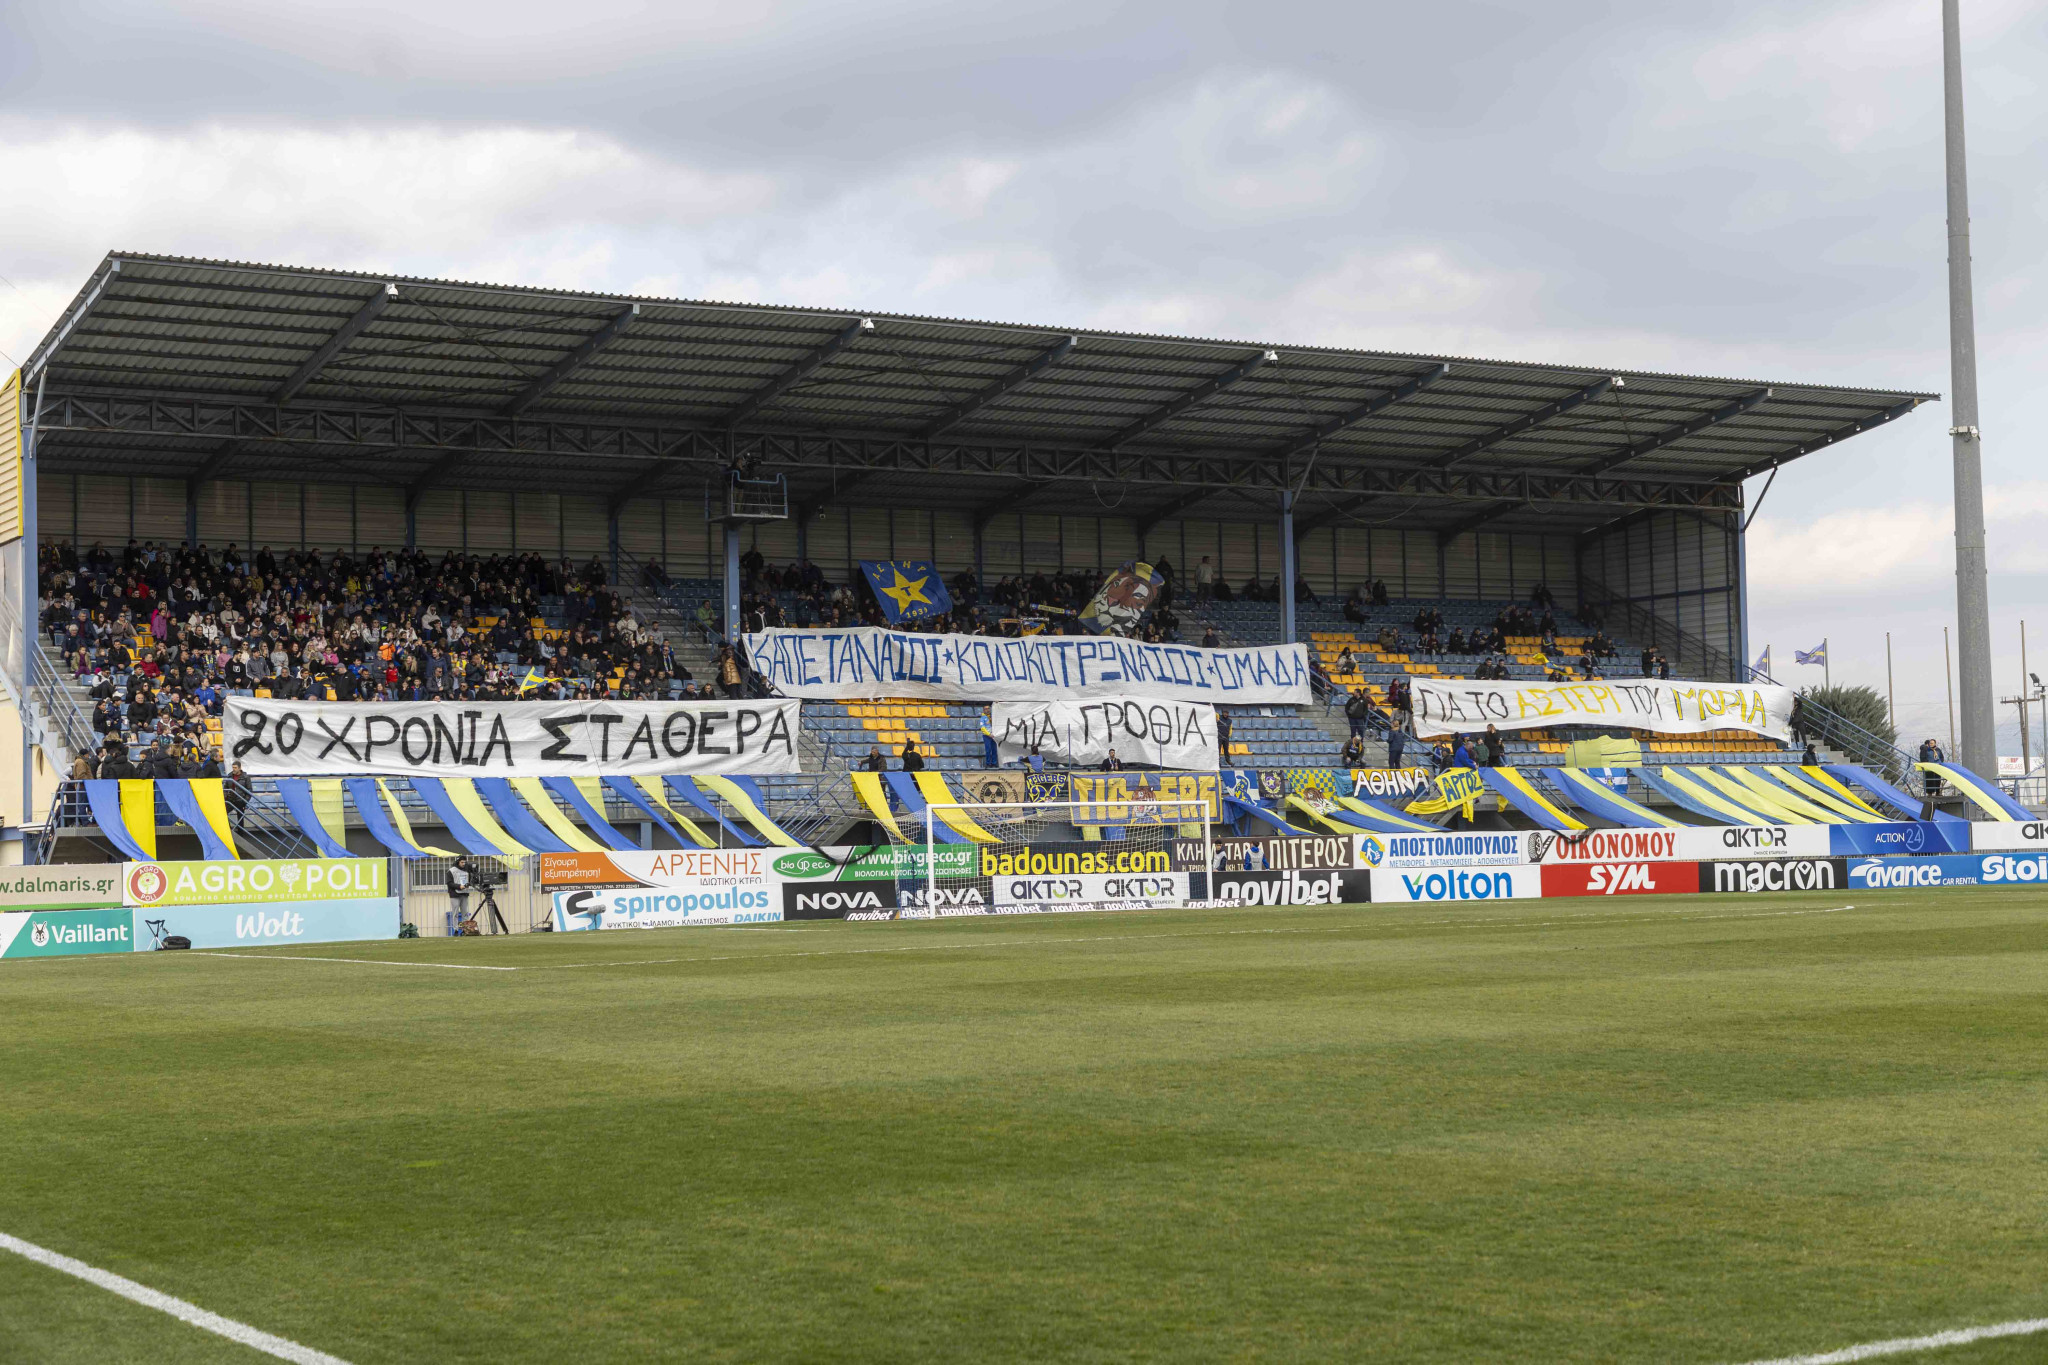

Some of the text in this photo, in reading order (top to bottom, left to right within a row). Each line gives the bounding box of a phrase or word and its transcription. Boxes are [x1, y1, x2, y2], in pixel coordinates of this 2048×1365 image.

[1212, 650, 1310, 691] ΟΜΑΔΑ
[1417, 686, 1467, 724] ΓΙΑ
[1465, 691, 1509, 721] ΤΟ
[1516, 684, 1622, 719] ΑΣΤΕΡΙ
[1615, 685, 1663, 721] ΤΟΥ
[998, 700, 1208, 749] ΜΙΑ ΓΡΟΘΙΑ
[231, 707, 793, 767] 20 ΧΡΟΝΙΑ ΣΤΑΘΕΡΑ
[1029, 774, 1065, 785] TIGERS
[1354, 768, 1430, 797] ΑΘΗΝΑ
[1442, 769, 1482, 803] ΑΡΓΟΣ
[1555, 832, 1676, 859] ΟΙΚΟΝΟΜΟΥ
[1875, 828, 1922, 844] ACTION 24
[1268, 837, 1350, 868] ΠΙΤΕΡΟΣ
[1389, 835, 1519, 858] ΑΠΟΣΤΟΛΟΠΟΥΛΟΣ
[544, 857, 578, 868] Σίγουρη
[649, 852, 763, 877] ΑΡΣΕΝΗΣ
[780, 859, 795, 869] bio
[811, 861, 831, 869] eco
[855, 850, 973, 867] www.biogeco.gr
[982, 846, 1171, 876] badounas.com
[1389, 859, 1426, 868] ΜΕΤΑΦΟΡΕΣ
[140, 866, 159, 875] AGRO
[174, 863, 378, 893] AGRO POLI
[544, 868, 601, 880] εξυπηρέτηση!
[854, 869, 889, 877] ΒΙΟΛΟΓΙΚΑ
[1586, 863, 1656, 895] SYM
[1714, 859, 1835, 892] macron
[1866, 864, 1942, 888] avance
[1955, 877, 1978, 885] RENTAL
[700, 877, 762, 886] ΙΔΙΩΤΙΚΟ ΚΤΕΟ
[1220, 871, 1344, 906] novibet
[1402, 869, 1513, 900] volton
[140, 893, 157, 901] POLI
[614, 886, 769, 919] spiropoulos
[796, 891, 883, 910] NOVA
[901, 887, 985, 906] NOVA
[1104, 899, 1149, 910] novibet
[1188, 897, 1241, 908] novibet
[847, 908, 893, 921] novibet
[940, 905, 987, 916] novibet
[995, 903, 1043, 914] novibet
[1050, 901, 1096, 912] novibet
[235, 910, 304, 938] Wolt
[607, 921, 641, 929] ΨΥΚΤΙΚΟΙ
[681, 917, 729, 926] ΚΛΙΜΑΤΙΣΜΟΣ
[733, 912, 781, 923] DAIKIN
[51, 924, 129, 944] Vaillant
